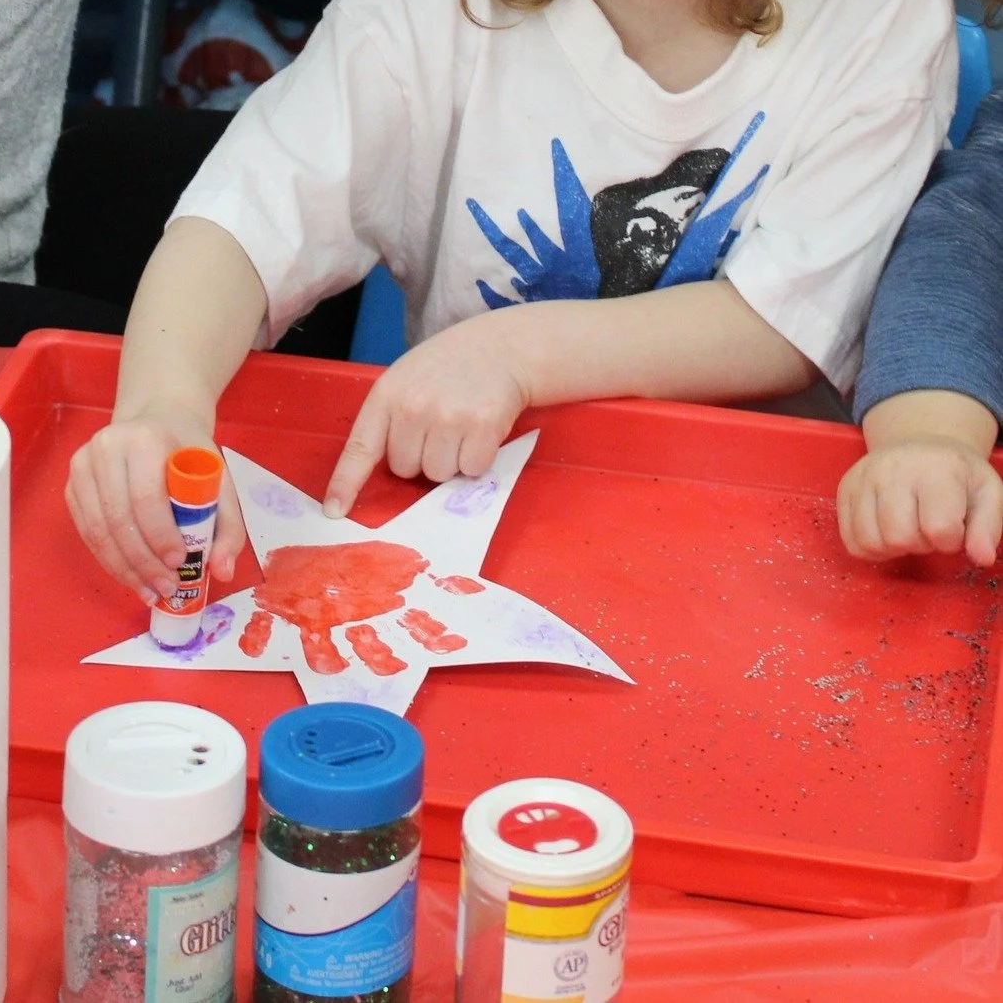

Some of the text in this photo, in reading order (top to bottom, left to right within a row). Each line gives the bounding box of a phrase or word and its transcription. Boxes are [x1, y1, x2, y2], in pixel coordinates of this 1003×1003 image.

[176, 588, 200, 600] ELM
[180, 903, 237, 956] Glitt
[561, 957, 585, 974] AP
